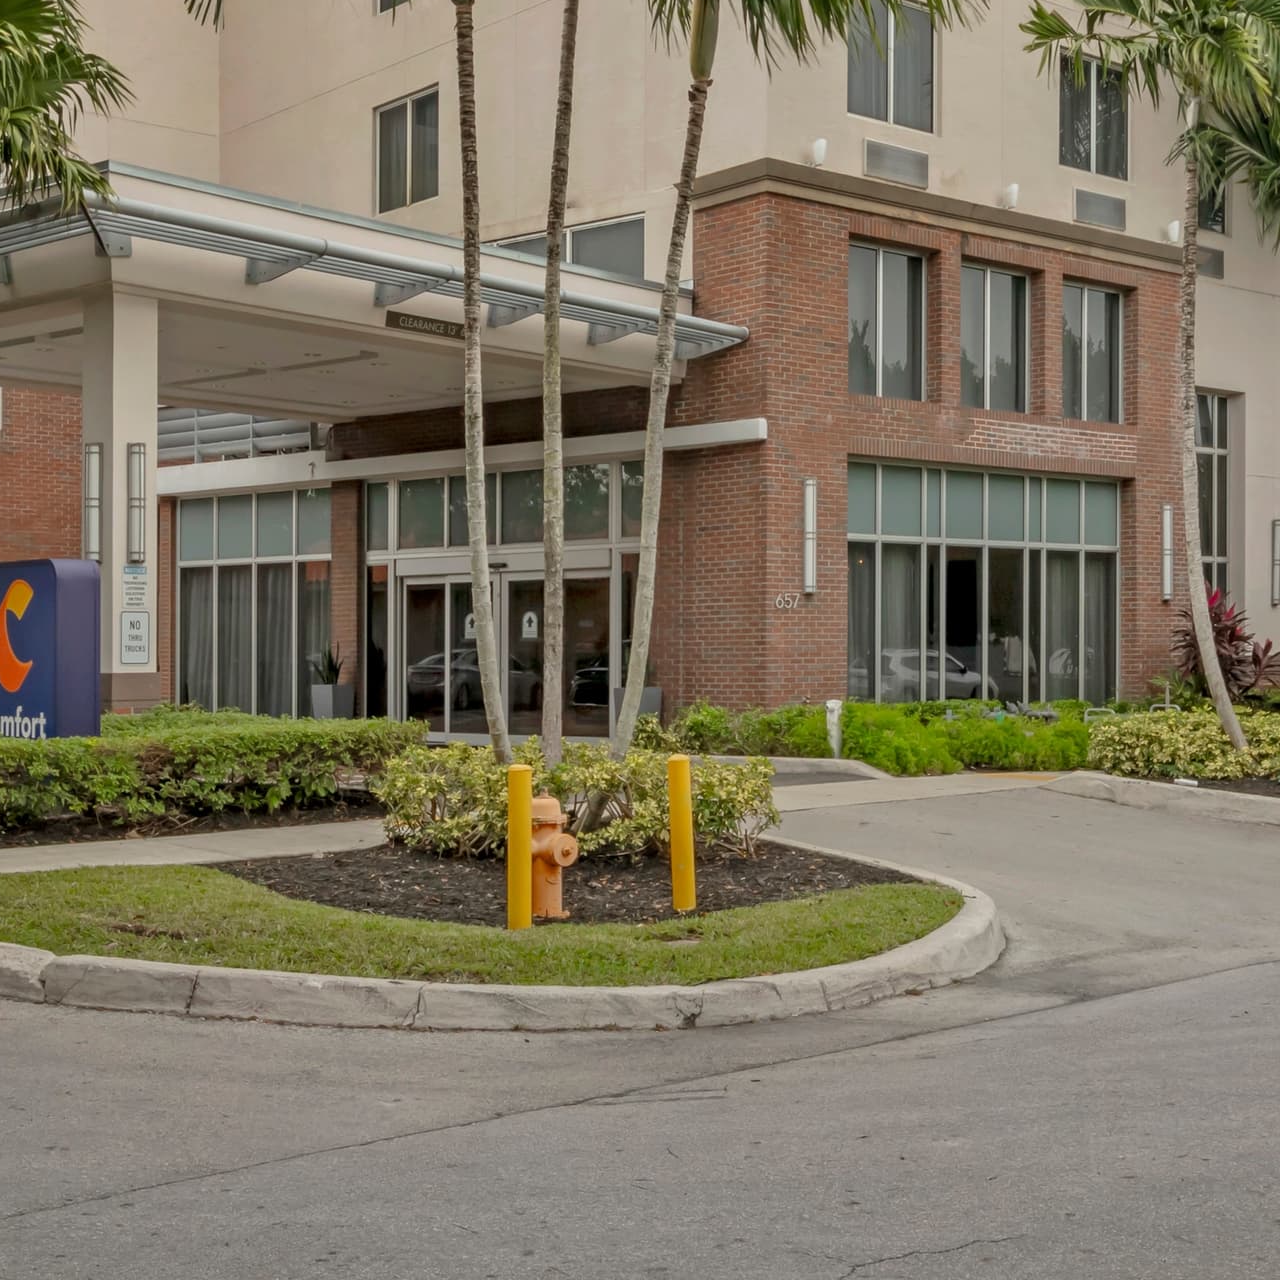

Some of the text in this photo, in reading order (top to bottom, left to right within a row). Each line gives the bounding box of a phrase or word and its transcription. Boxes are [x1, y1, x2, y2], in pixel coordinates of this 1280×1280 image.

[399, 315, 445, 334] CLEARANCE
[775, 592, 800, 609] 657
[129, 619, 141, 631] NO
